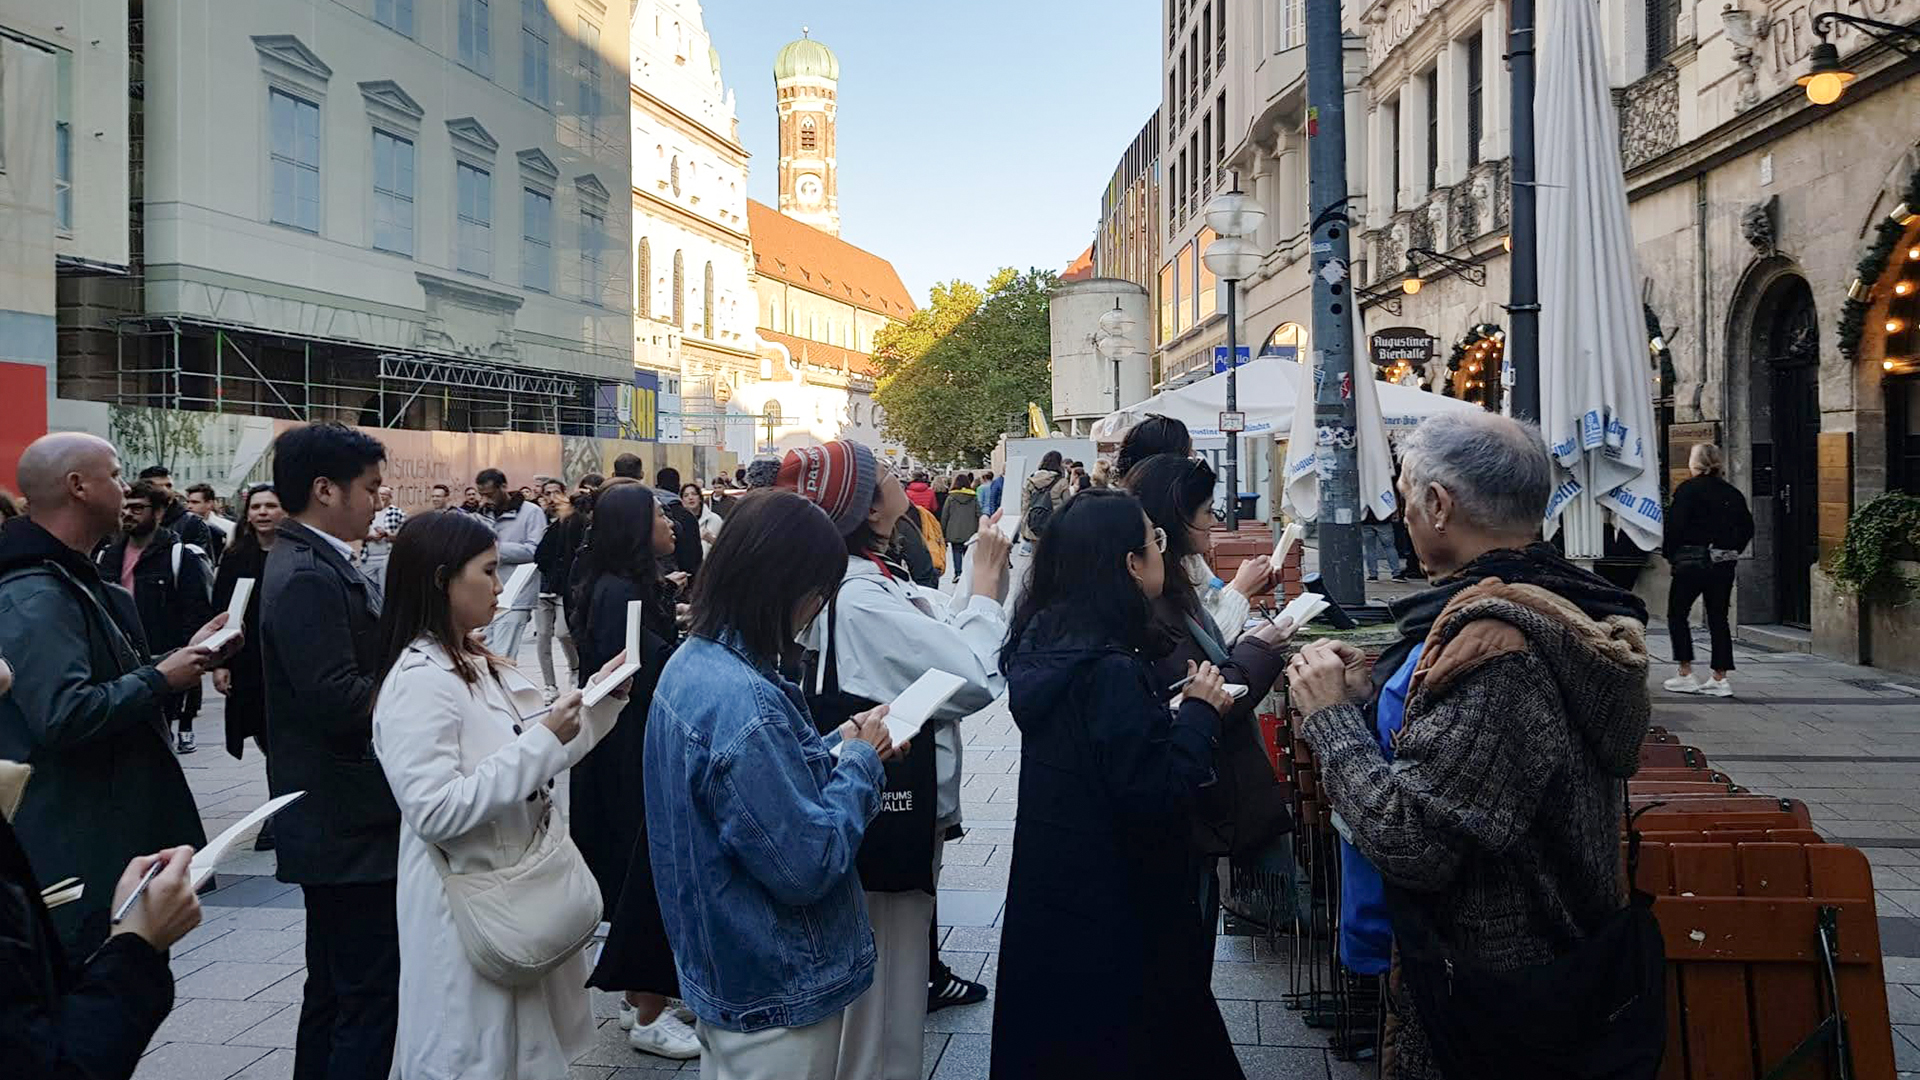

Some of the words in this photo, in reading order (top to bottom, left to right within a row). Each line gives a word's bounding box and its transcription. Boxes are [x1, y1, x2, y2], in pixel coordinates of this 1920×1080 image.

[1374, 336, 1430, 348] Augustiner
[1216, 353, 1249, 366] Apllo
[1378, 348, 1425, 360] Bierhalle
[882, 790, 913, 801] RFUMS
[882, 800, 914, 812] ALLE
